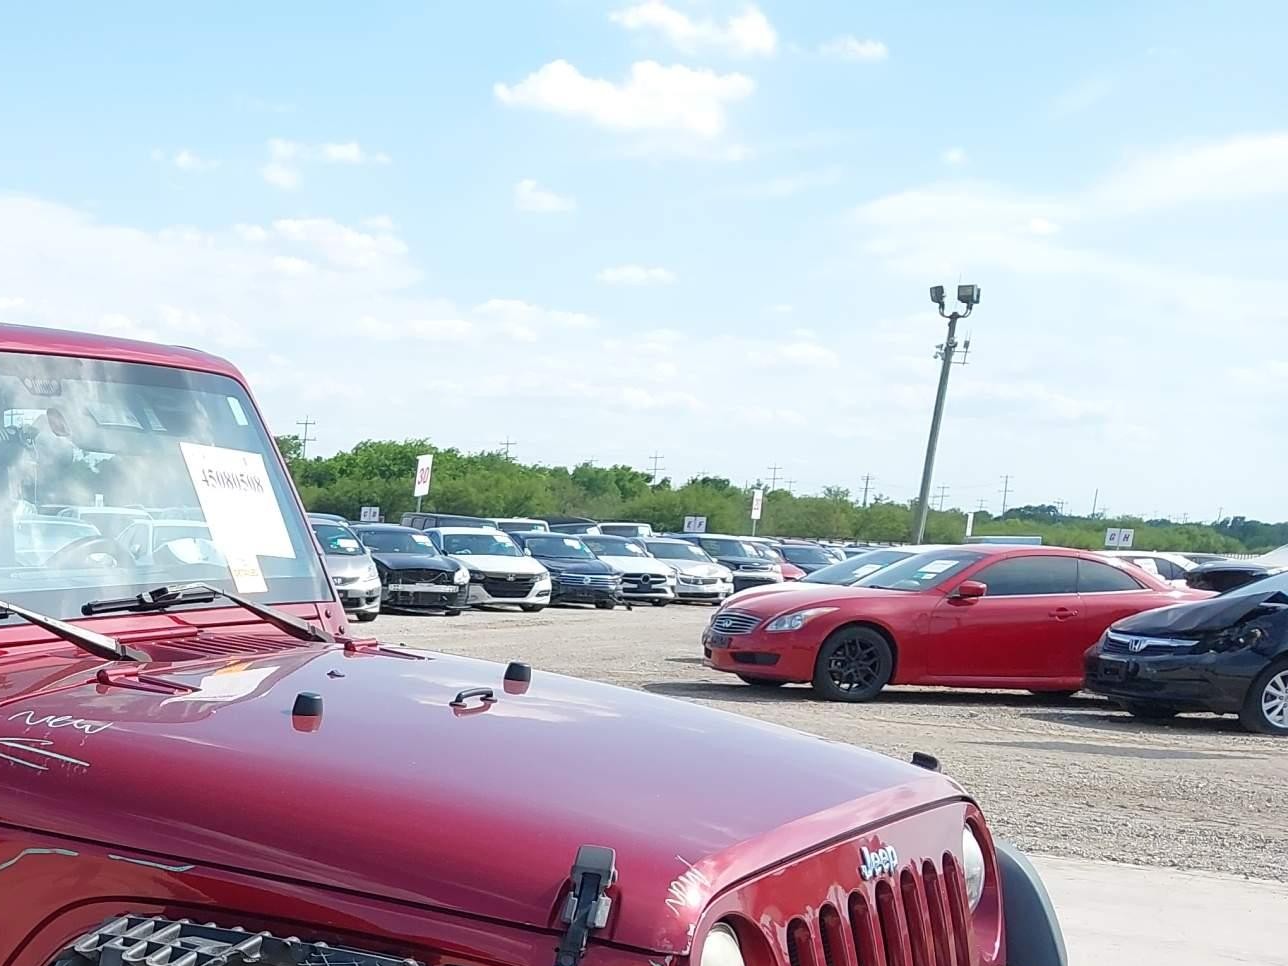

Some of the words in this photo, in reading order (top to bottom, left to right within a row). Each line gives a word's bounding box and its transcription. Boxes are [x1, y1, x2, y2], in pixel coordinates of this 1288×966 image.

[417, 466, 430, 485] 30
[1122, 533, 1130, 542] H
[859, 846, 898, 880] Jeep
